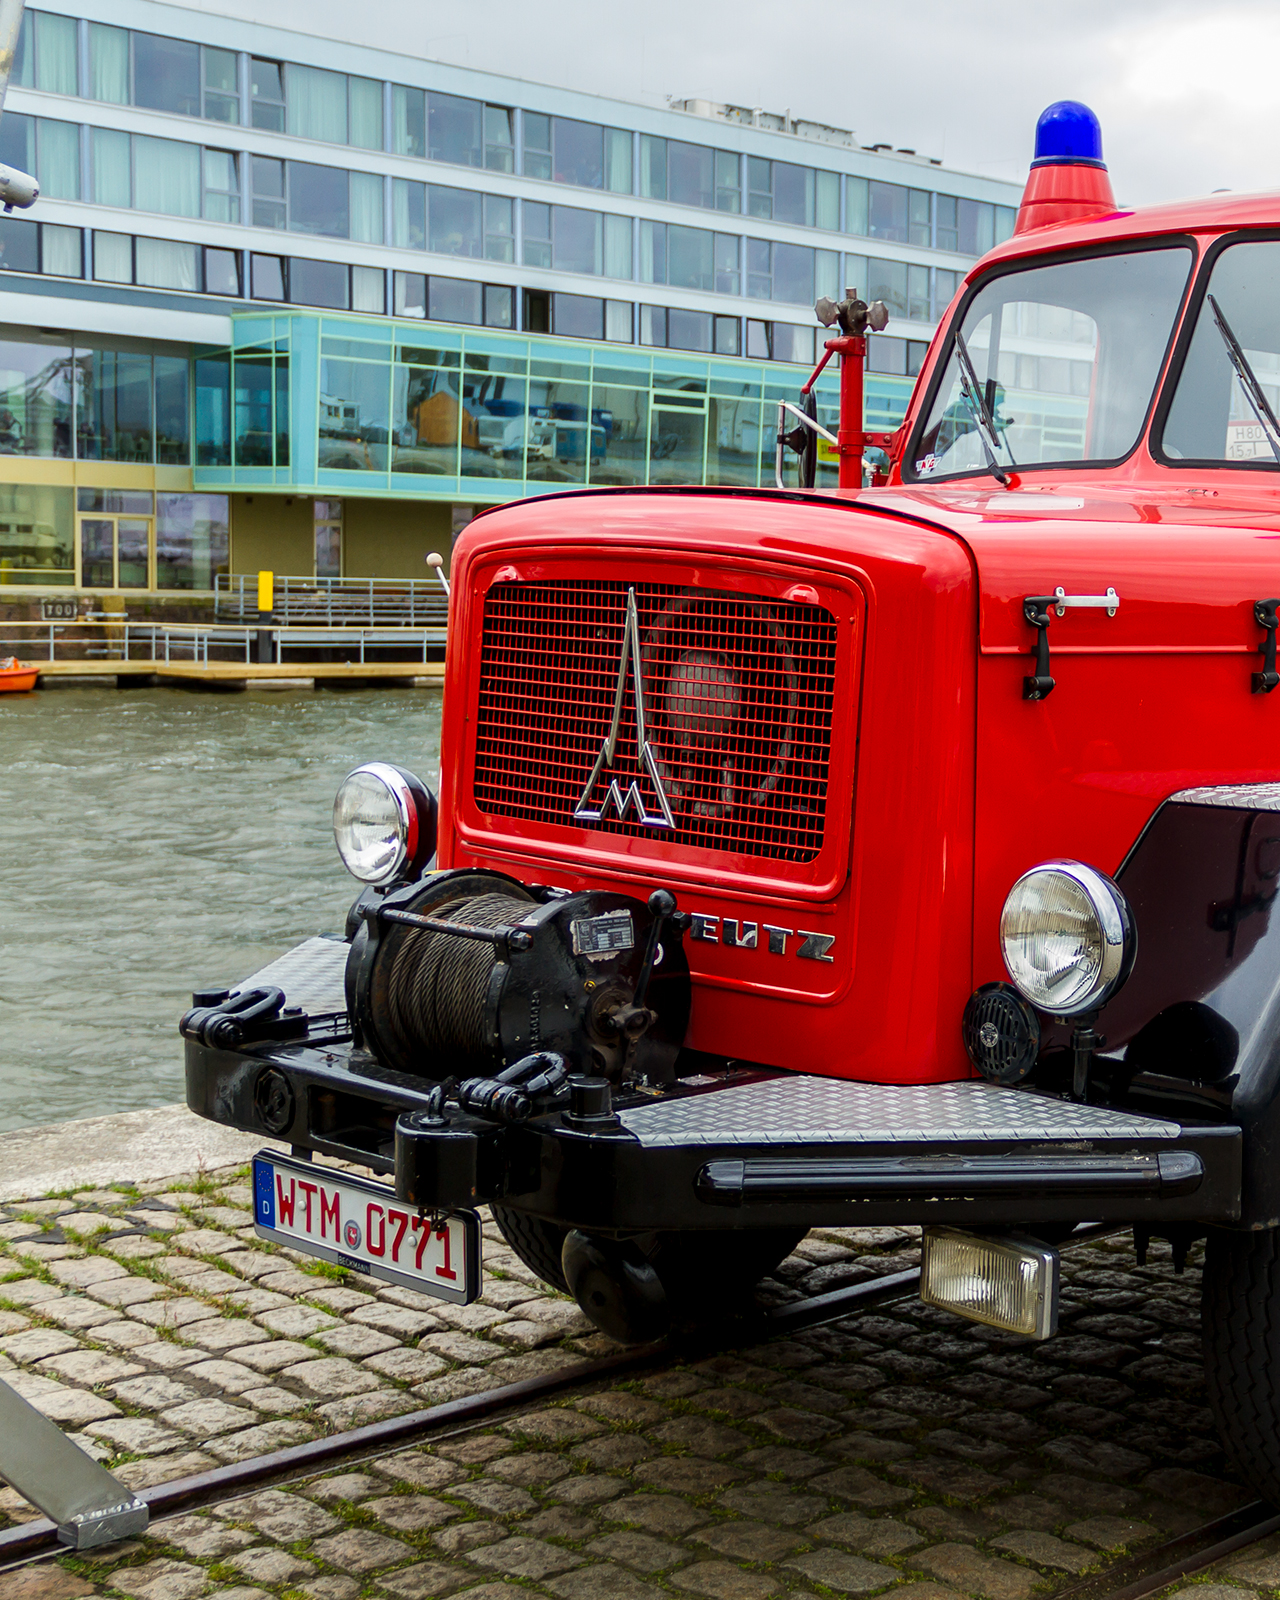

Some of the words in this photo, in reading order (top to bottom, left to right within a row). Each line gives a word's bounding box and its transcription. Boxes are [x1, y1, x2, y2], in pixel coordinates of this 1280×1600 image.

[689, 912, 836, 963] EUTZ
[262, 1200, 270, 1215] D
[276, 1173, 341, 1243] WTM
[366, 1200, 457, 1281] 0771
